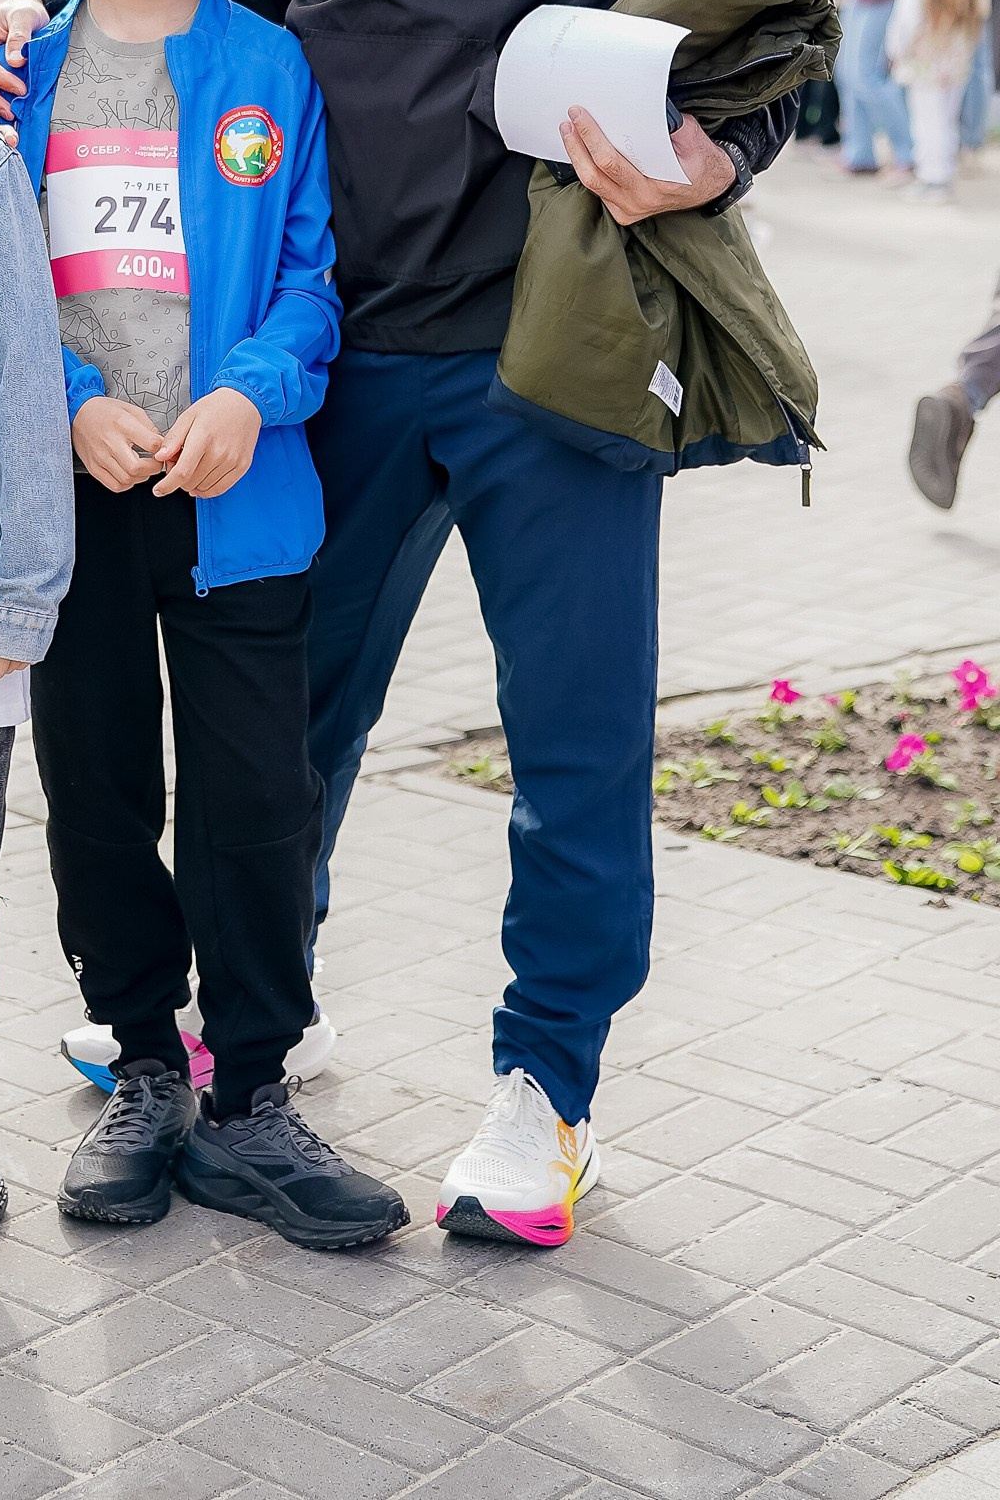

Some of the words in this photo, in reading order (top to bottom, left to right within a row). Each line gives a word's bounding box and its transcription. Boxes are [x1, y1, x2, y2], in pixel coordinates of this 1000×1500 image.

[90, 144, 121, 155] СБЕР
[134, 150, 166, 159] марафон
[124, 181, 143, 191] 7-9
[147, 182, 170, 193] ЛЕТ
[94, 195, 176, 236] 274
